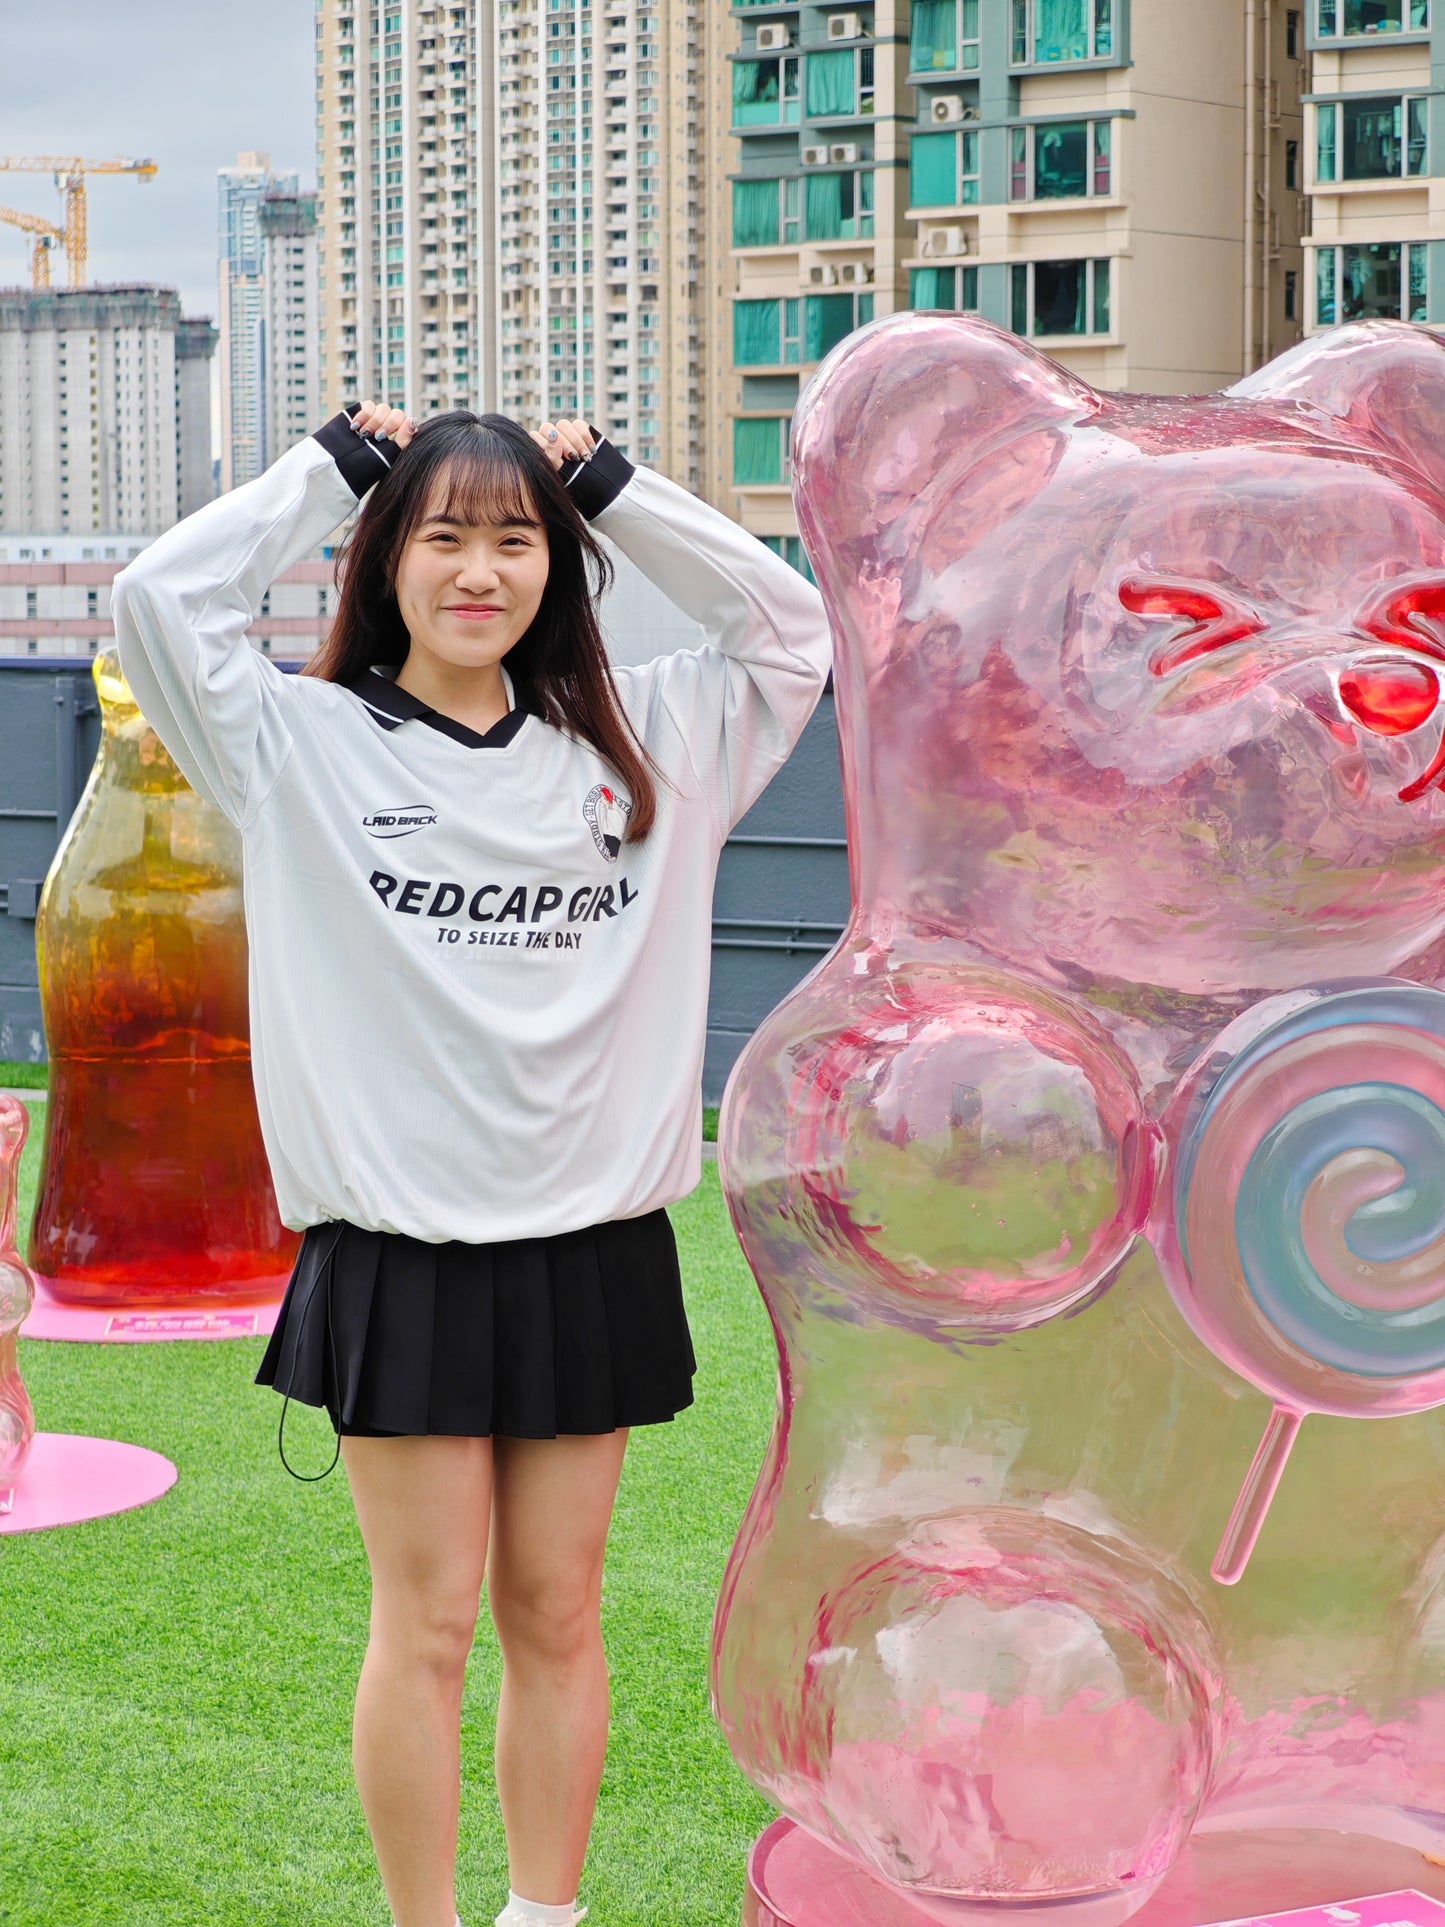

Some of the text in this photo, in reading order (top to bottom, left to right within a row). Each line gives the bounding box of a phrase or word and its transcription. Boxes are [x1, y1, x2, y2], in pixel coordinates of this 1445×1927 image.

[585, 804, 594, 816] GET
[362, 815, 439, 827] LAID BACK
[567, 876, 639, 923] GIRL
[437, 927, 582, 950] TO SEIZE THE DAY
